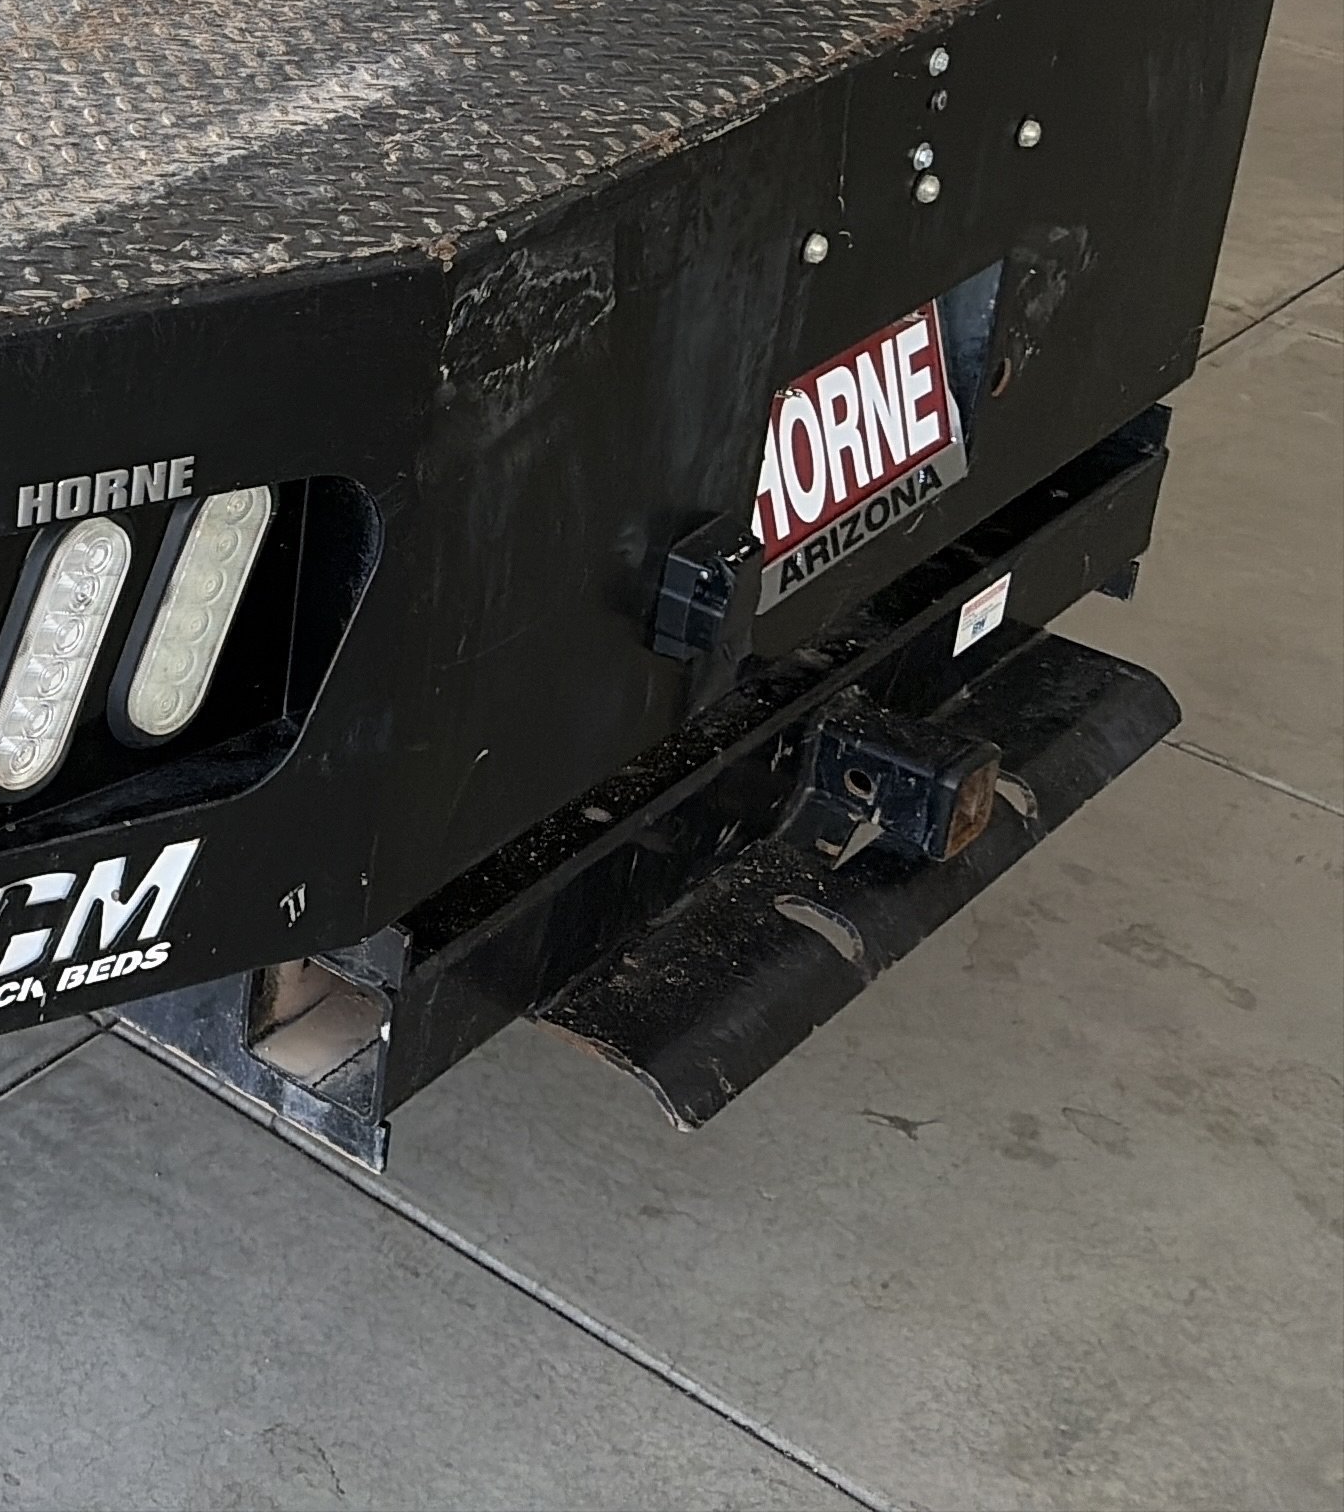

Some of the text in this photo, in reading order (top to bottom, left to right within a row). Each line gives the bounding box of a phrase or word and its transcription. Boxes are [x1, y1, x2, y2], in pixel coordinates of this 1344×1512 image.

[750, 319, 941, 545] HORNE
[17, 455, 195, 528] HORNE
[778, 464, 943, 595] ARIZONA
[55, 941, 172, 992] BEDS
